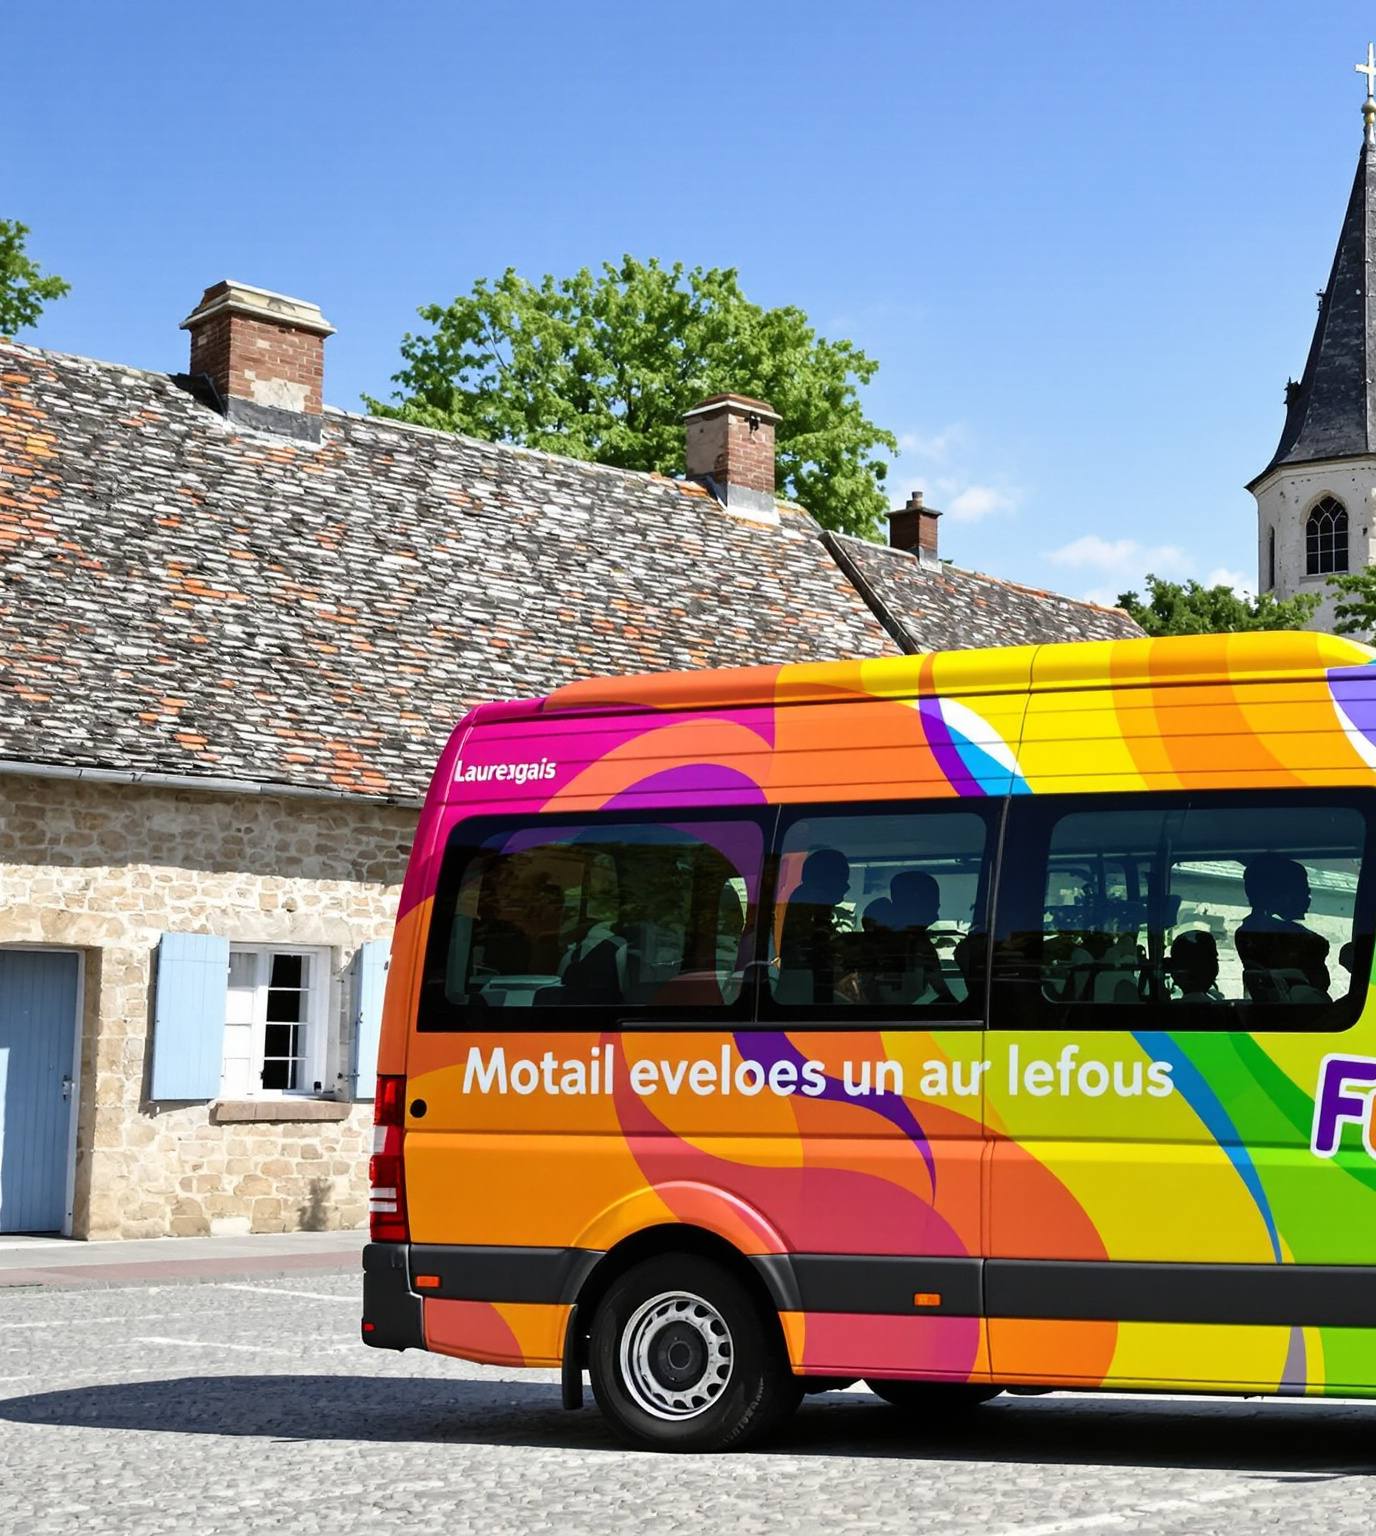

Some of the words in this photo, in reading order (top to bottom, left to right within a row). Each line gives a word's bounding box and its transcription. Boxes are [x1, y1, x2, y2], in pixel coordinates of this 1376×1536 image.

[462, 1043, 615, 1095] Motail
[629, 1044, 827, 1097] eveloes
[843, 1060, 904, 1097] un
[919, 1060, 992, 1097] aur
[1008, 1044, 1175, 1097] lefous
